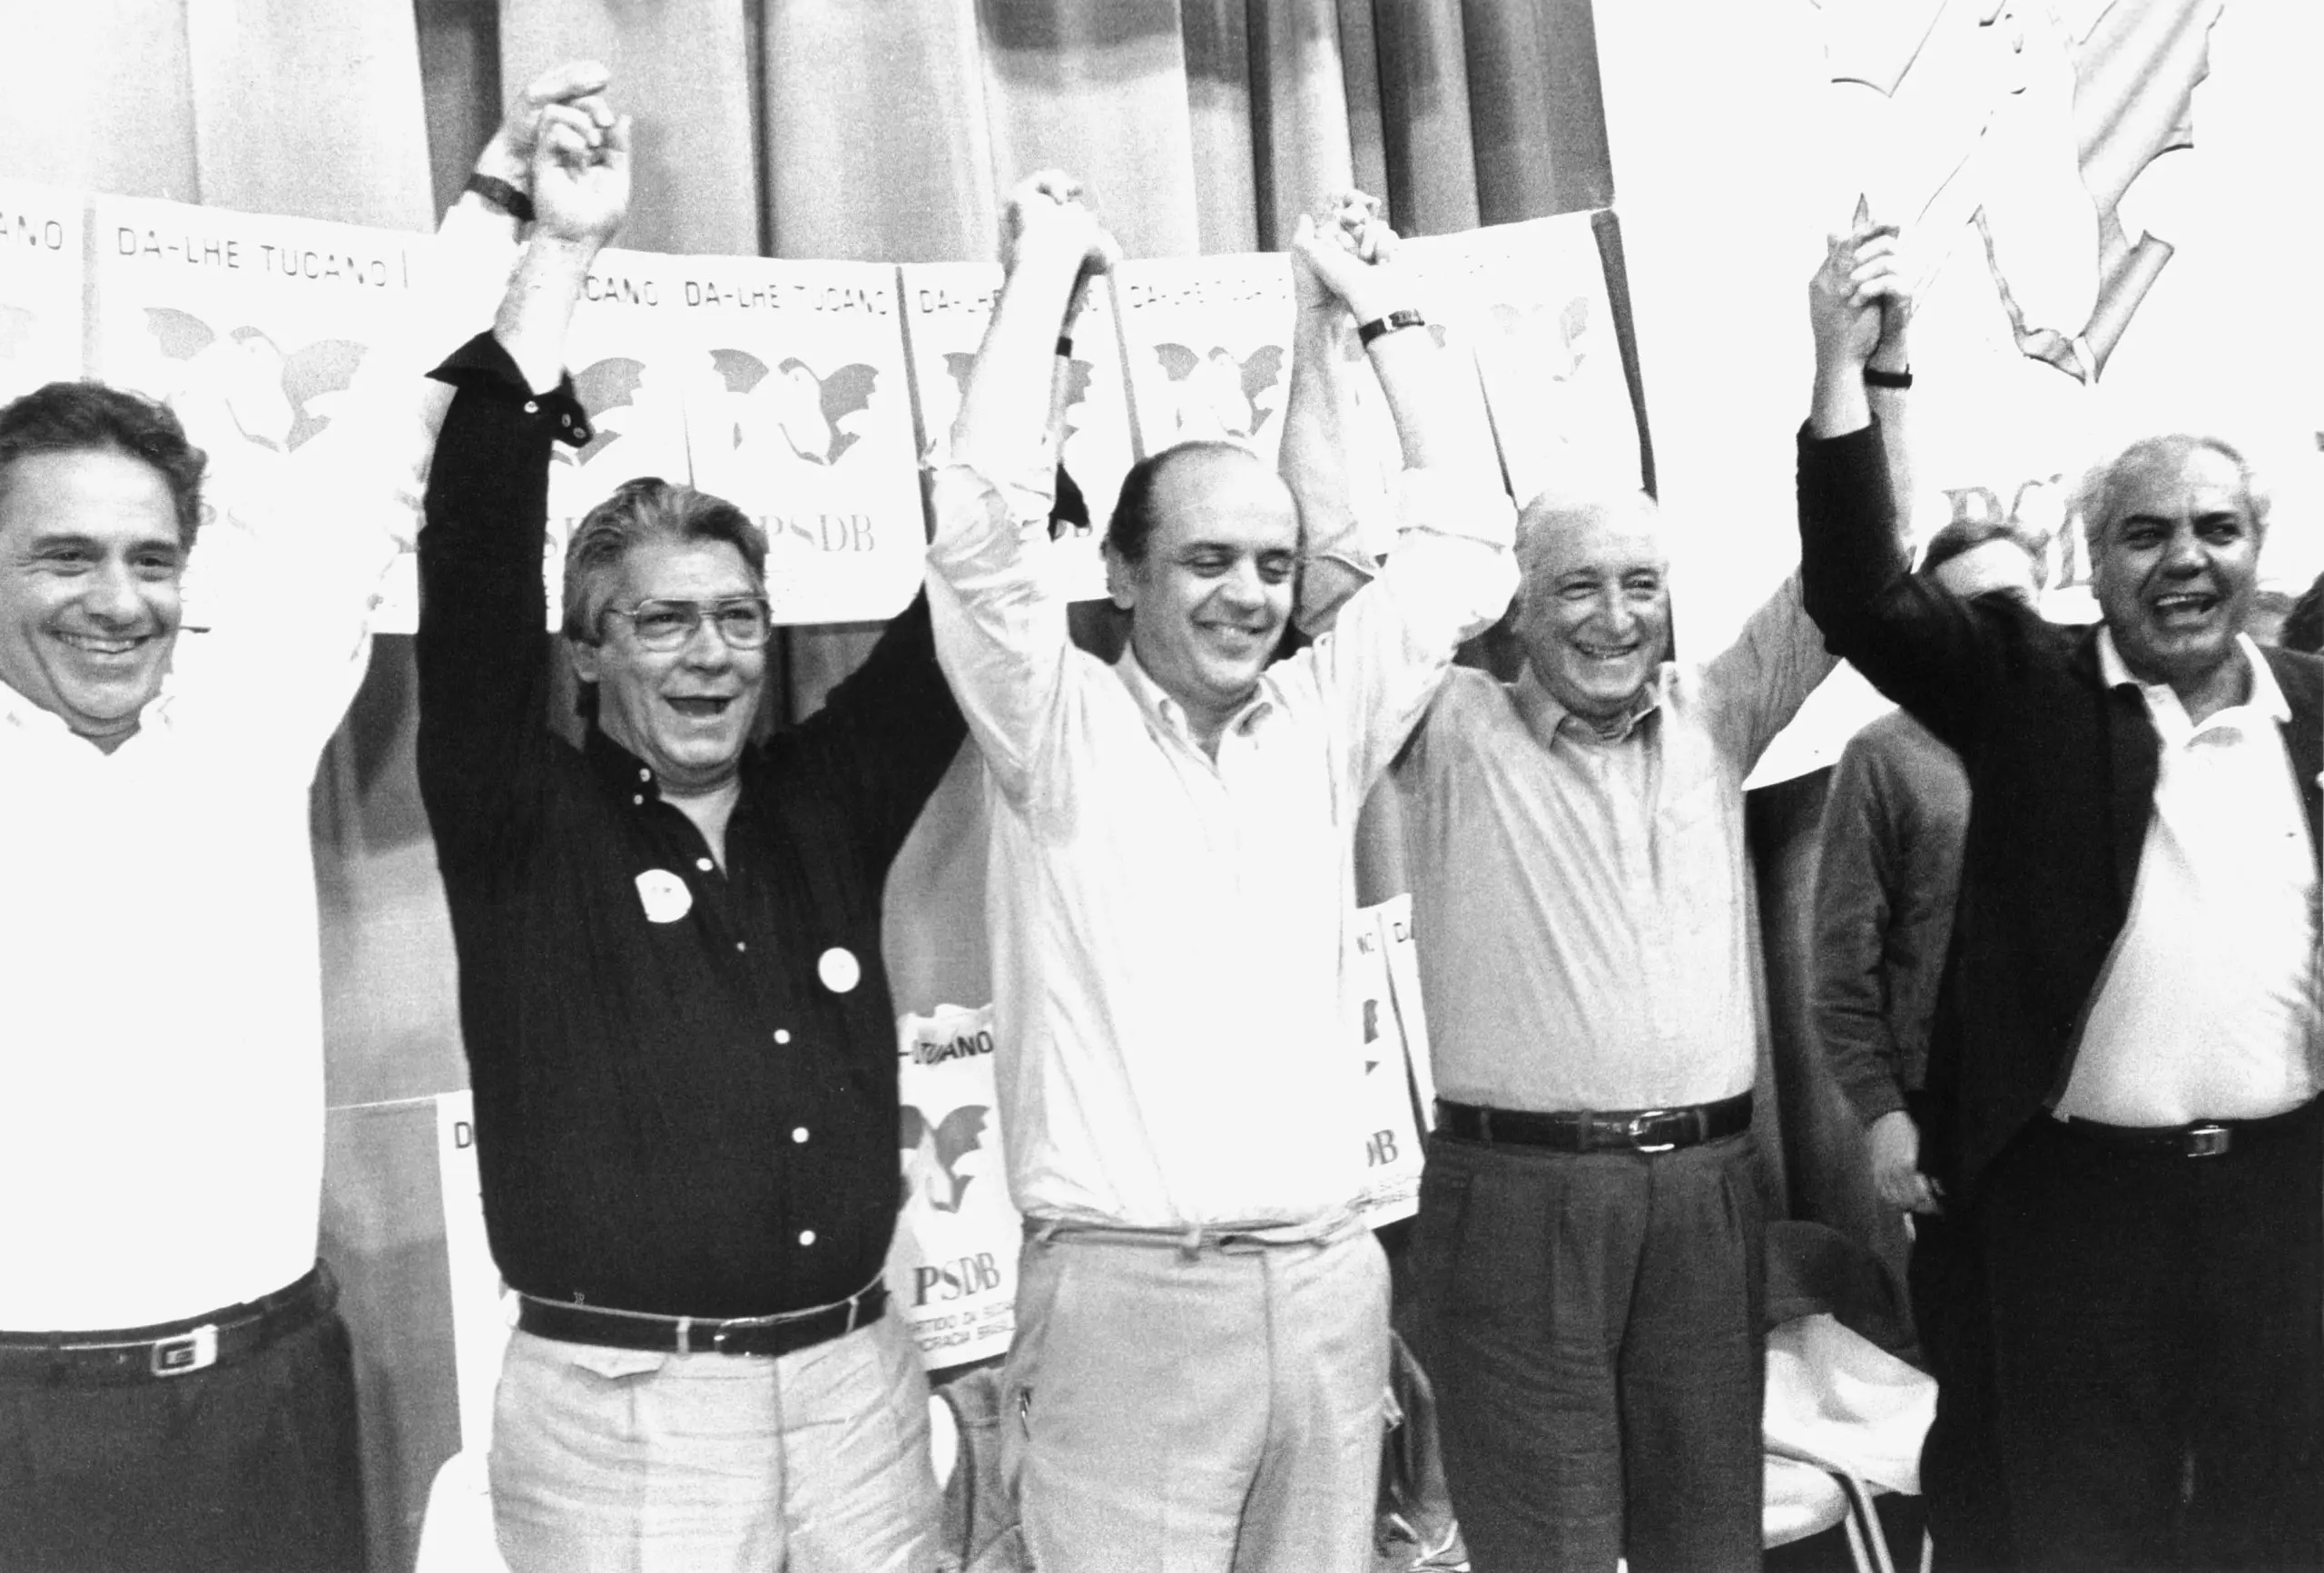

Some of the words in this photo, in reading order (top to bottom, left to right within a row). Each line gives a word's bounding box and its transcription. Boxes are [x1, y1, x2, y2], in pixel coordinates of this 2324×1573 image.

[117, 226, 240, 269] DA-LHE
[260, 243, 387, 287] TUCANO
[581, 275, 658, 307] CANO
[684, 280, 781, 308] DA-LHE
[759, 514, 874, 552] PSDB
[910, 1252, 1000, 1308] PSDB
